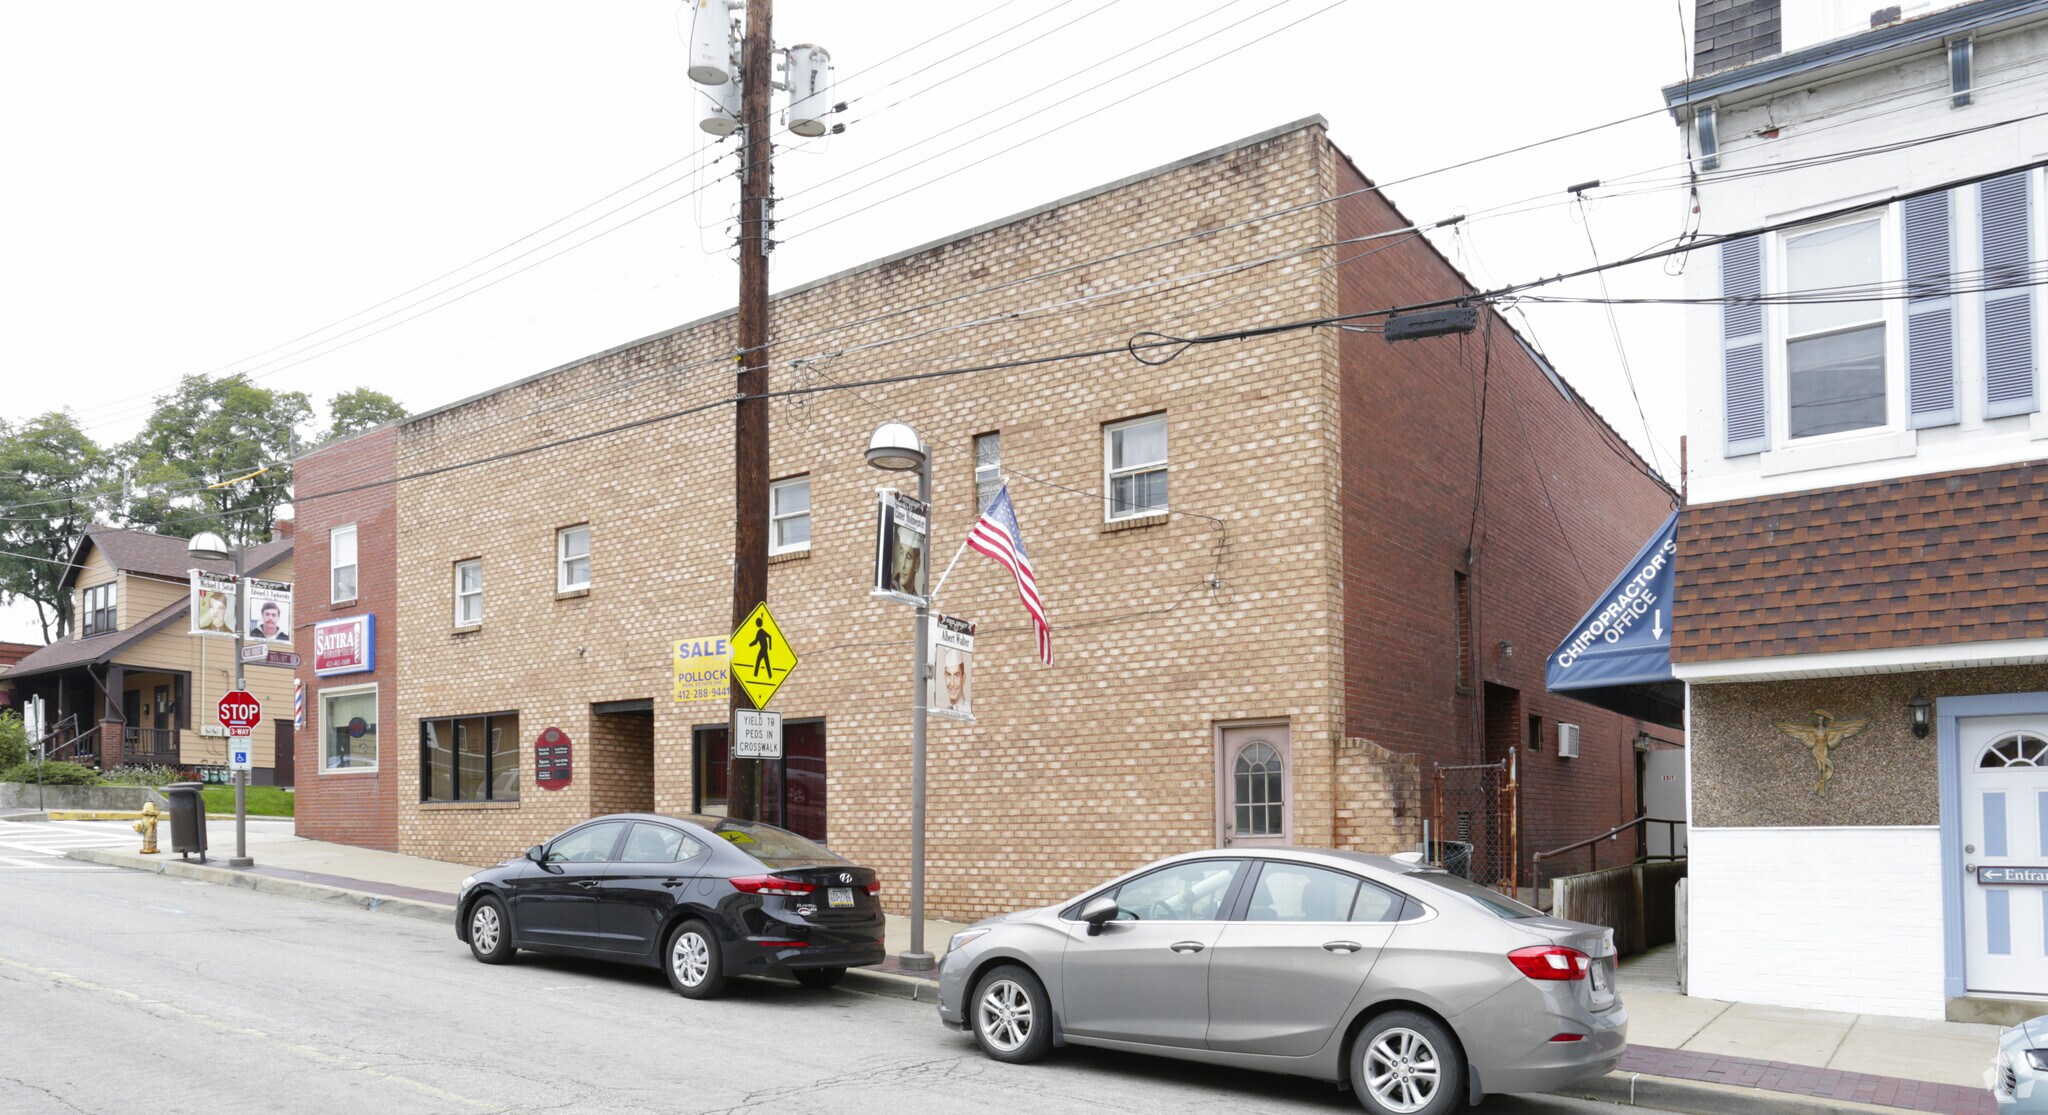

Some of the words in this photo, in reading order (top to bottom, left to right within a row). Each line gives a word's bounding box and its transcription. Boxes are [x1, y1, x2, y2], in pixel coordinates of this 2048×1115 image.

[1558, 539, 1677, 667] CHIROPRACTOR'S
[1604, 588, 1657, 643] OFFICE
[317, 631, 354, 655] SATIRA
[942, 629, 955, 643] Albert
[680, 639, 726, 659] SALE
[678, 669, 727, 682] POLLOCK
[220, 703, 259, 720] STOP
[744, 716, 763, 726] YIELD
[767, 717, 775, 727] TO
[745, 729, 763, 739] PEDS
[766, 730, 774, 739] IN
[740, 741, 778, 752] CROSSWALK
[2005, 869, 2048, 881] Entra
